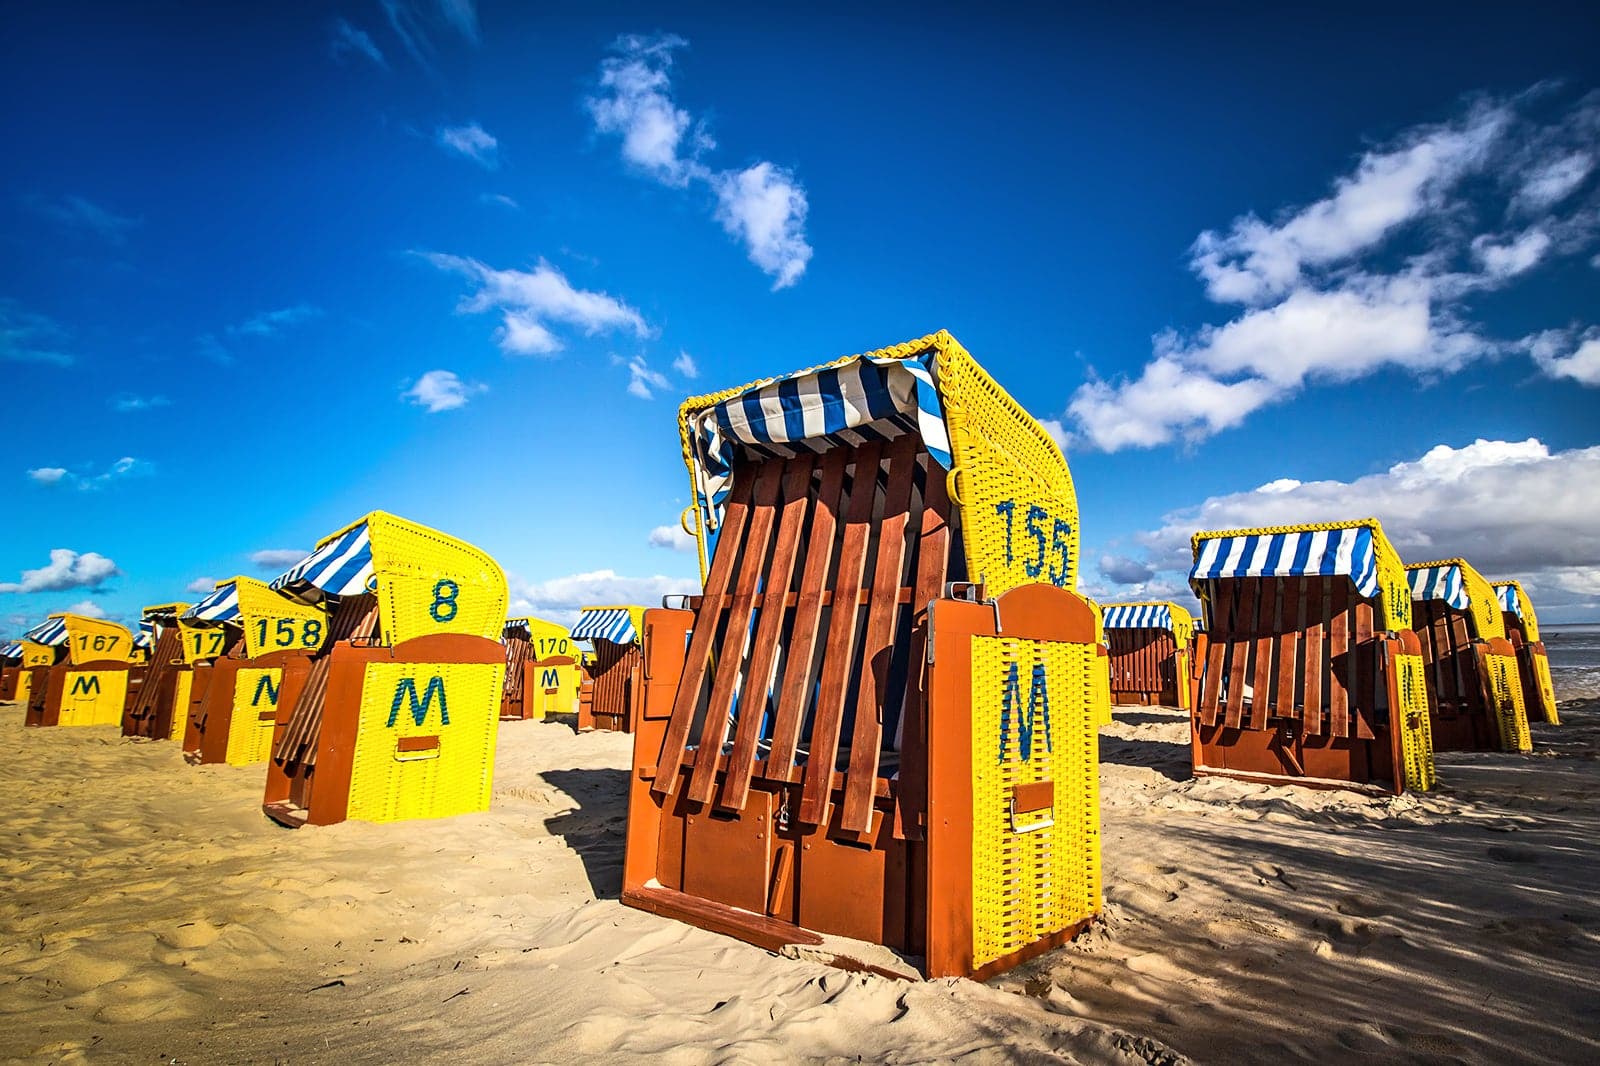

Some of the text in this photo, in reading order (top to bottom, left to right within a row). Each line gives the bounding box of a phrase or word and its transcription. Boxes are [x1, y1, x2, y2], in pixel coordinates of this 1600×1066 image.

[996, 499, 1071, 587] 155
[429, 579, 459, 623] 8
[78, 635, 120, 652] 167
[256, 618, 321, 647] 158
[539, 638, 568, 654] 170
[30, 655, 49, 663] 45
[70, 675, 101, 695] M
[541, 668, 560, 687] M
[385, 676, 450, 728] M
[998, 661, 1051, 765] M
